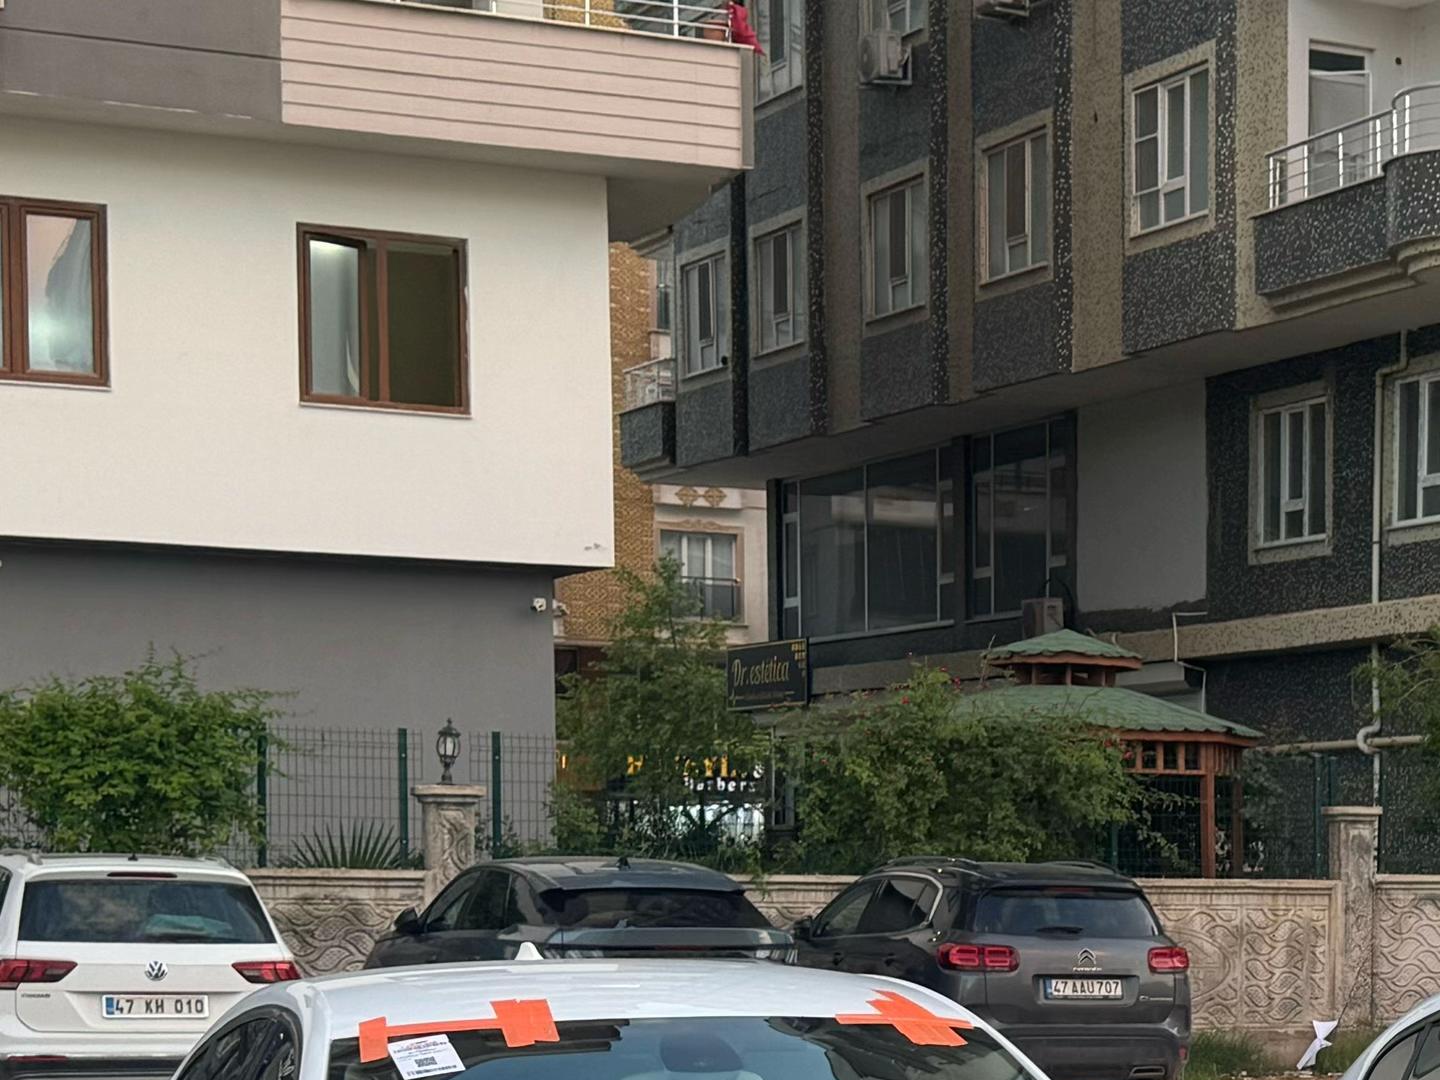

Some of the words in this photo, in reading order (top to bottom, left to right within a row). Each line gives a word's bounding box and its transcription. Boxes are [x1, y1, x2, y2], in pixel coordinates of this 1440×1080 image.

[1053, 980, 1069, 994] 47
[1071, 980, 1095, 994] AAU
[1095, 980, 1120, 994] 707
[115, 999, 135, 1014] 47
[174, 999, 205, 1014] 010
